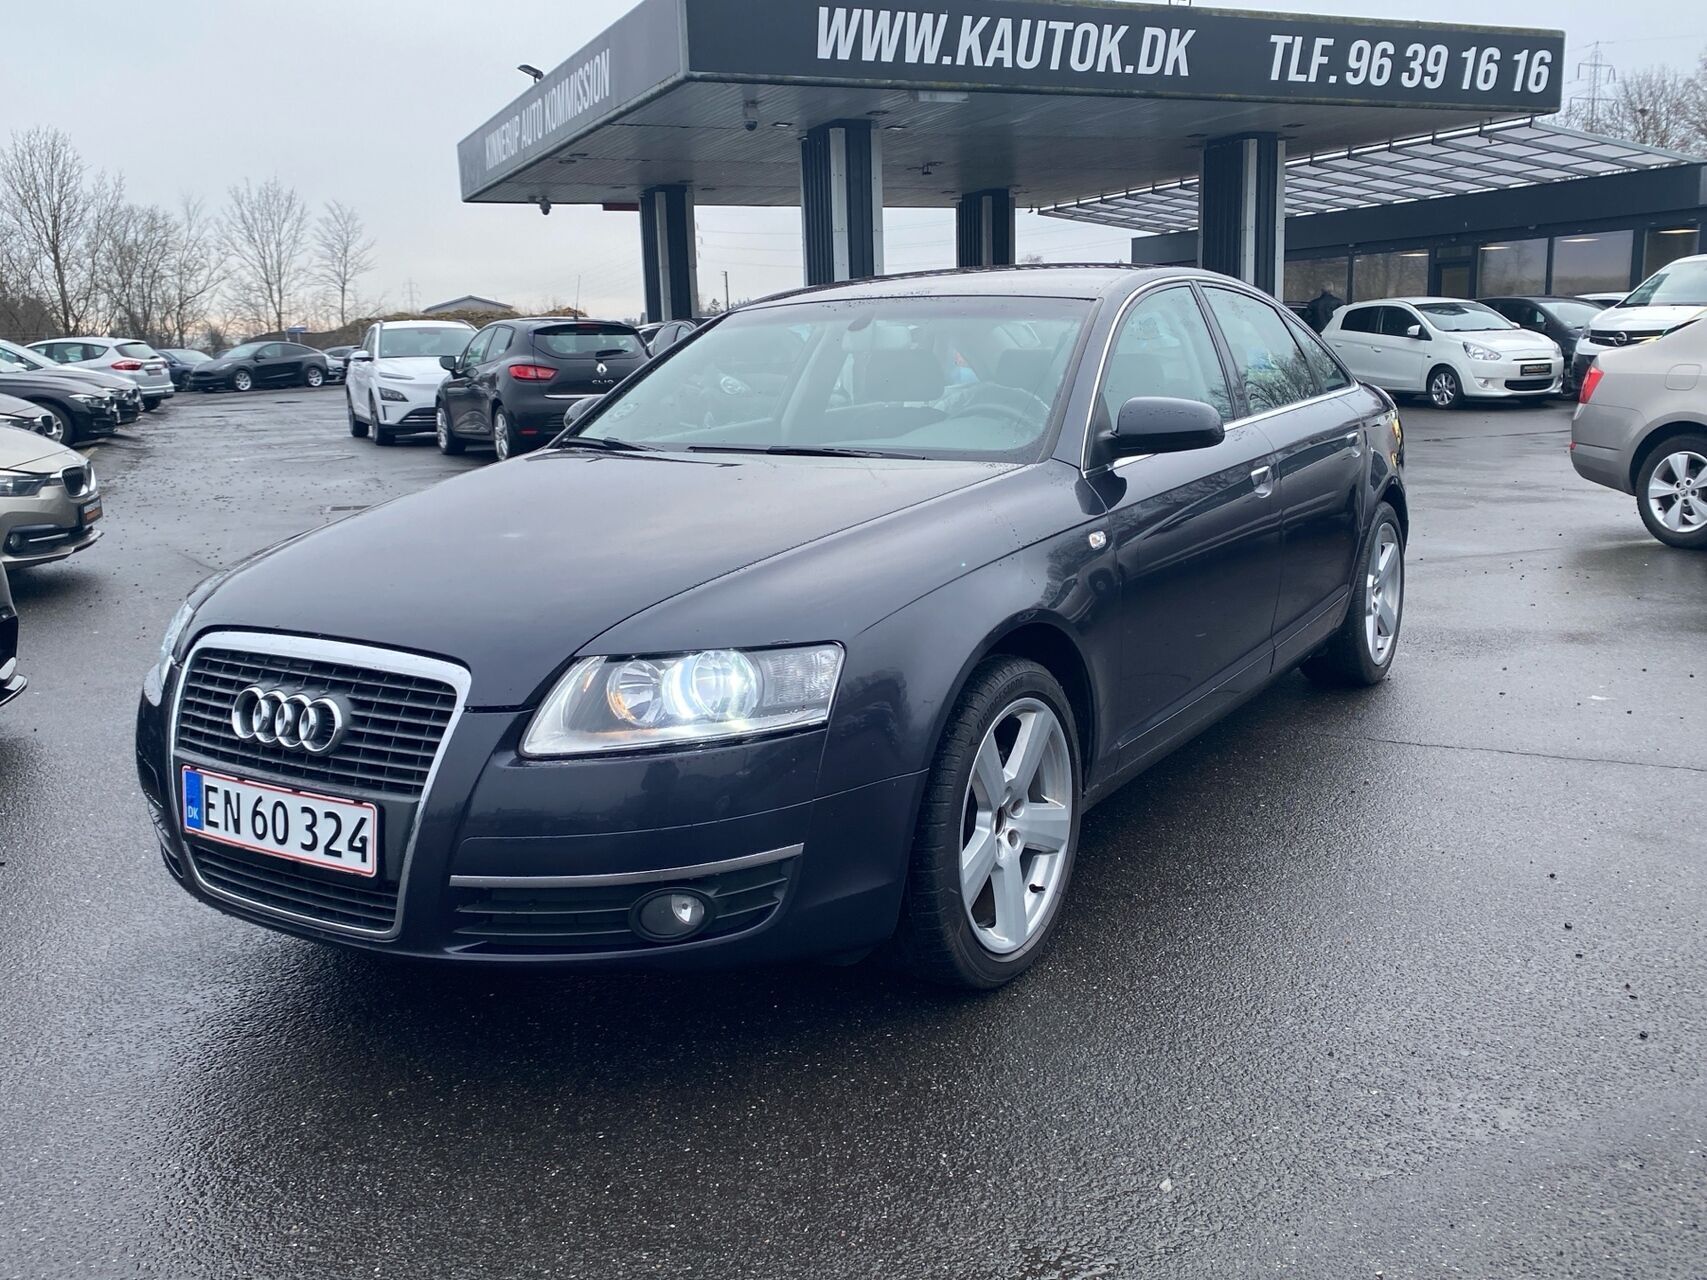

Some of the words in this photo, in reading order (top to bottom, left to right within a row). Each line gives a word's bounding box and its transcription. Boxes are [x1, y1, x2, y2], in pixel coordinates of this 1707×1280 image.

[817, 6, 1197, 77] WWW.KAUTOK.DK
[1270, 34, 1337, 84] TLF.
[1345, 39, 1395, 87] 96
[1401, 43, 1449, 89] 39
[1461, 46, 1501, 91] 16
[1512, 49, 1552, 93] 16
[521, 98, 543, 149] AUTO
[545, 48, 610, 134] KOMMISSION
[187, 806, 199, 820] DK
[204, 784, 241, 835] EN
[251, 795, 289, 846] 60
[300, 806, 368, 863] 324
